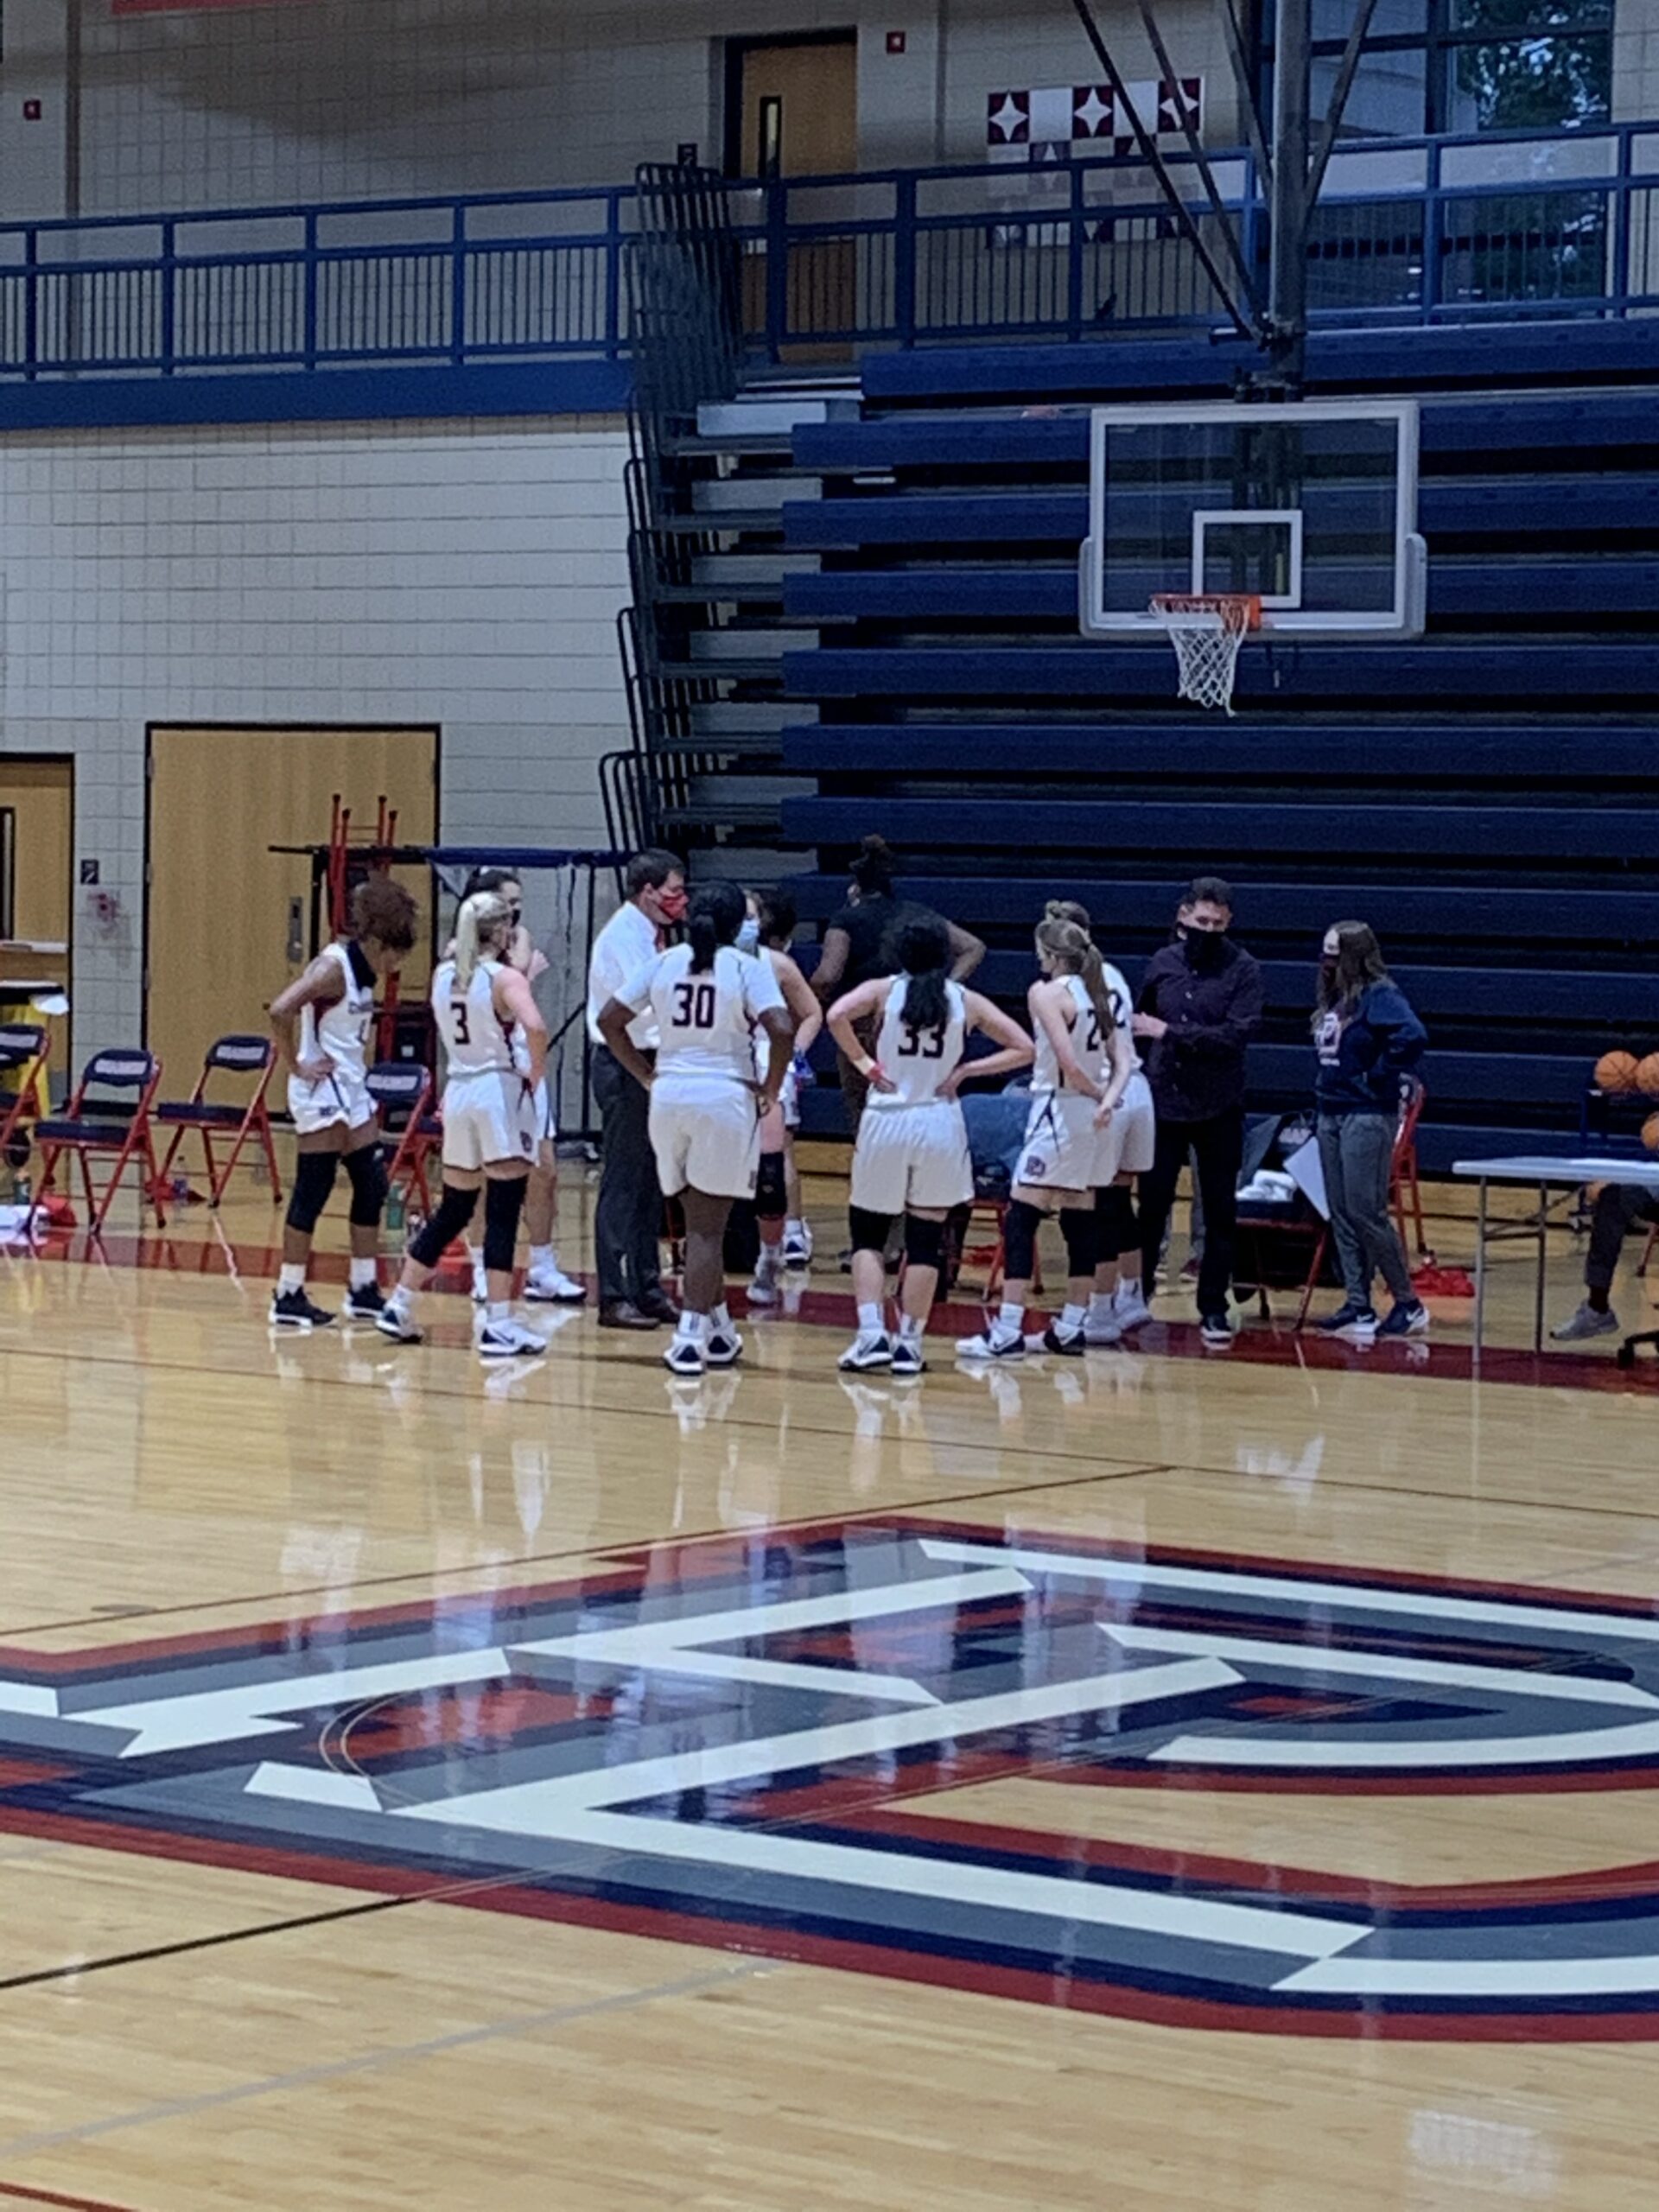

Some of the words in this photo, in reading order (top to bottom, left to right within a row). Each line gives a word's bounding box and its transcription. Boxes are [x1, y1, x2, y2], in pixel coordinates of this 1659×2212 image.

[450, 1001, 470, 1046] 3
[672, 982, 716, 1028] 30
[898, 1020, 947, 1059] 33
